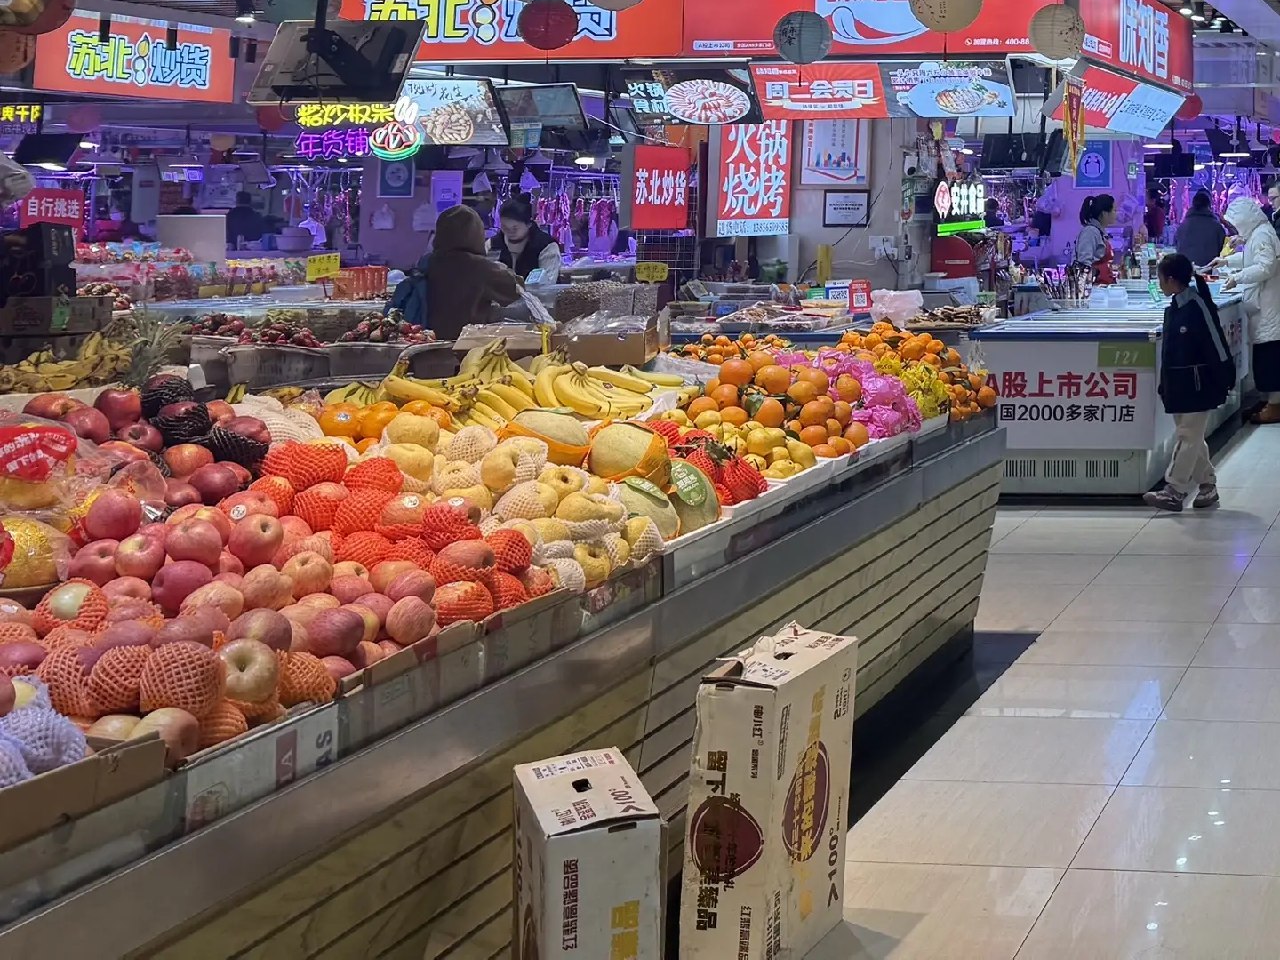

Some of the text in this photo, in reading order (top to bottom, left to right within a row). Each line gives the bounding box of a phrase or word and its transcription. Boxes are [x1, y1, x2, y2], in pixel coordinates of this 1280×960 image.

[68, 32, 210, 86] 苏北炒货
[765, 79, 874, 99] 周二会员日
[725, 119, 788, 165] 火锅
[635, 168, 687, 206] 苏北炒货
[722, 163, 787, 217] 烧烤
[27, 197, 80, 219] 自行挑选
[985, 371, 1137, 399] A股上市公司
[1000, 403, 1135, 422] 国2000多家门店
